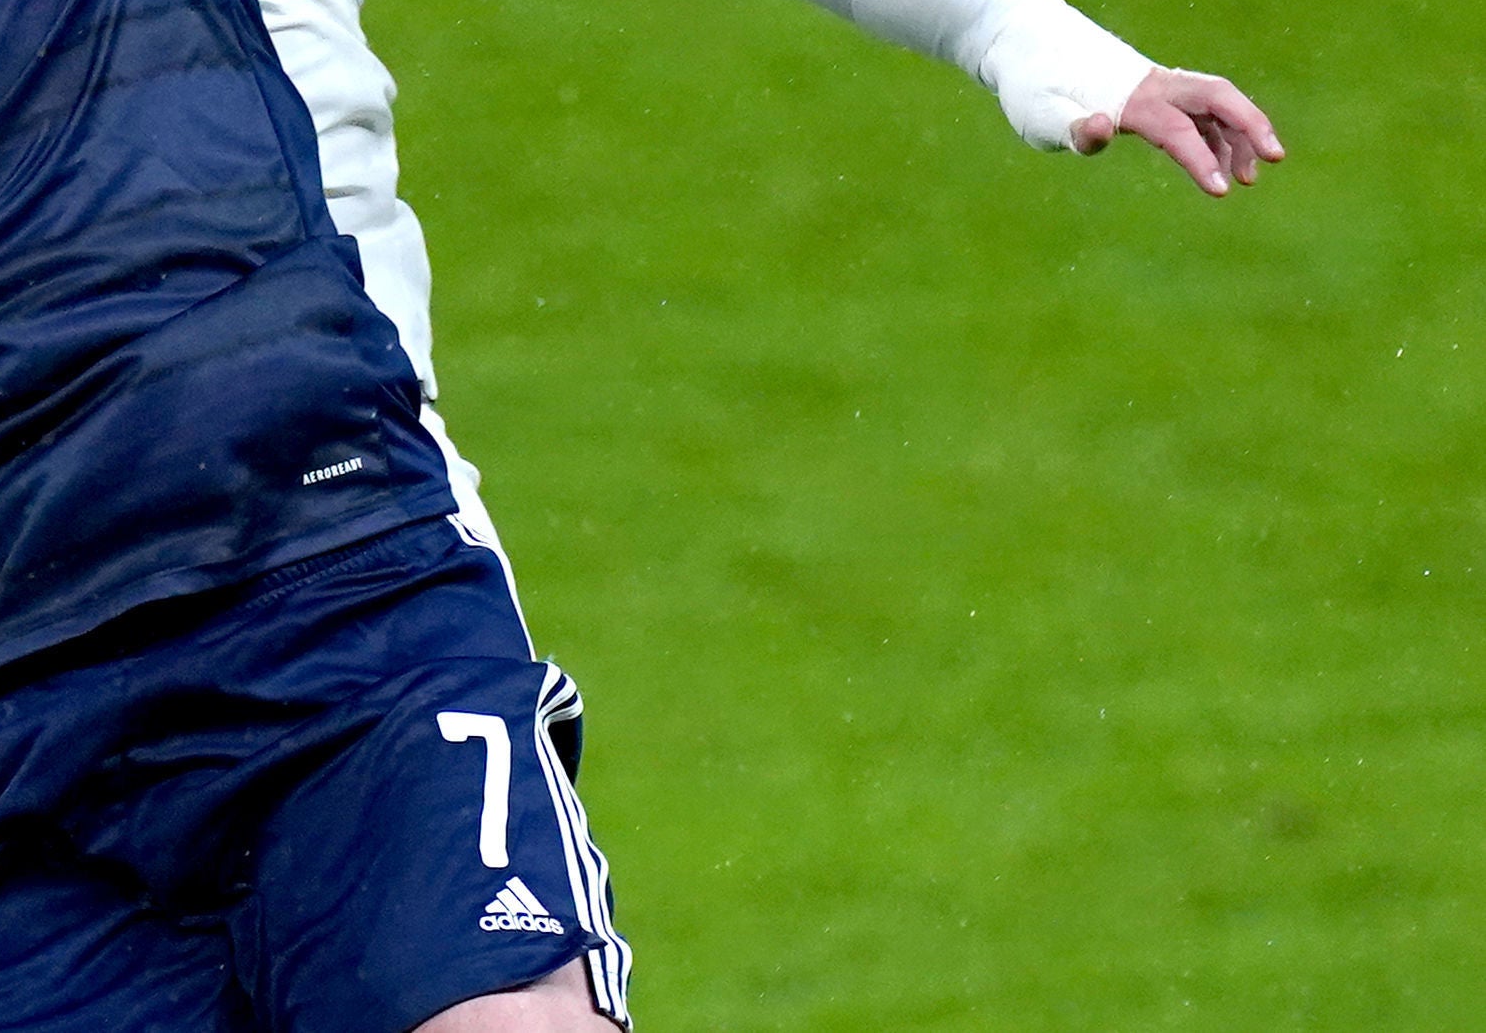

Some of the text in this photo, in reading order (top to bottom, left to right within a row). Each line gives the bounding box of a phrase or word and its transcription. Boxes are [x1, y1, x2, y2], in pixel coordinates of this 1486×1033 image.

[303, 457, 363, 485] AEROREADY
[436, 711, 512, 868] 7
[479, 912, 564, 935] adidas
